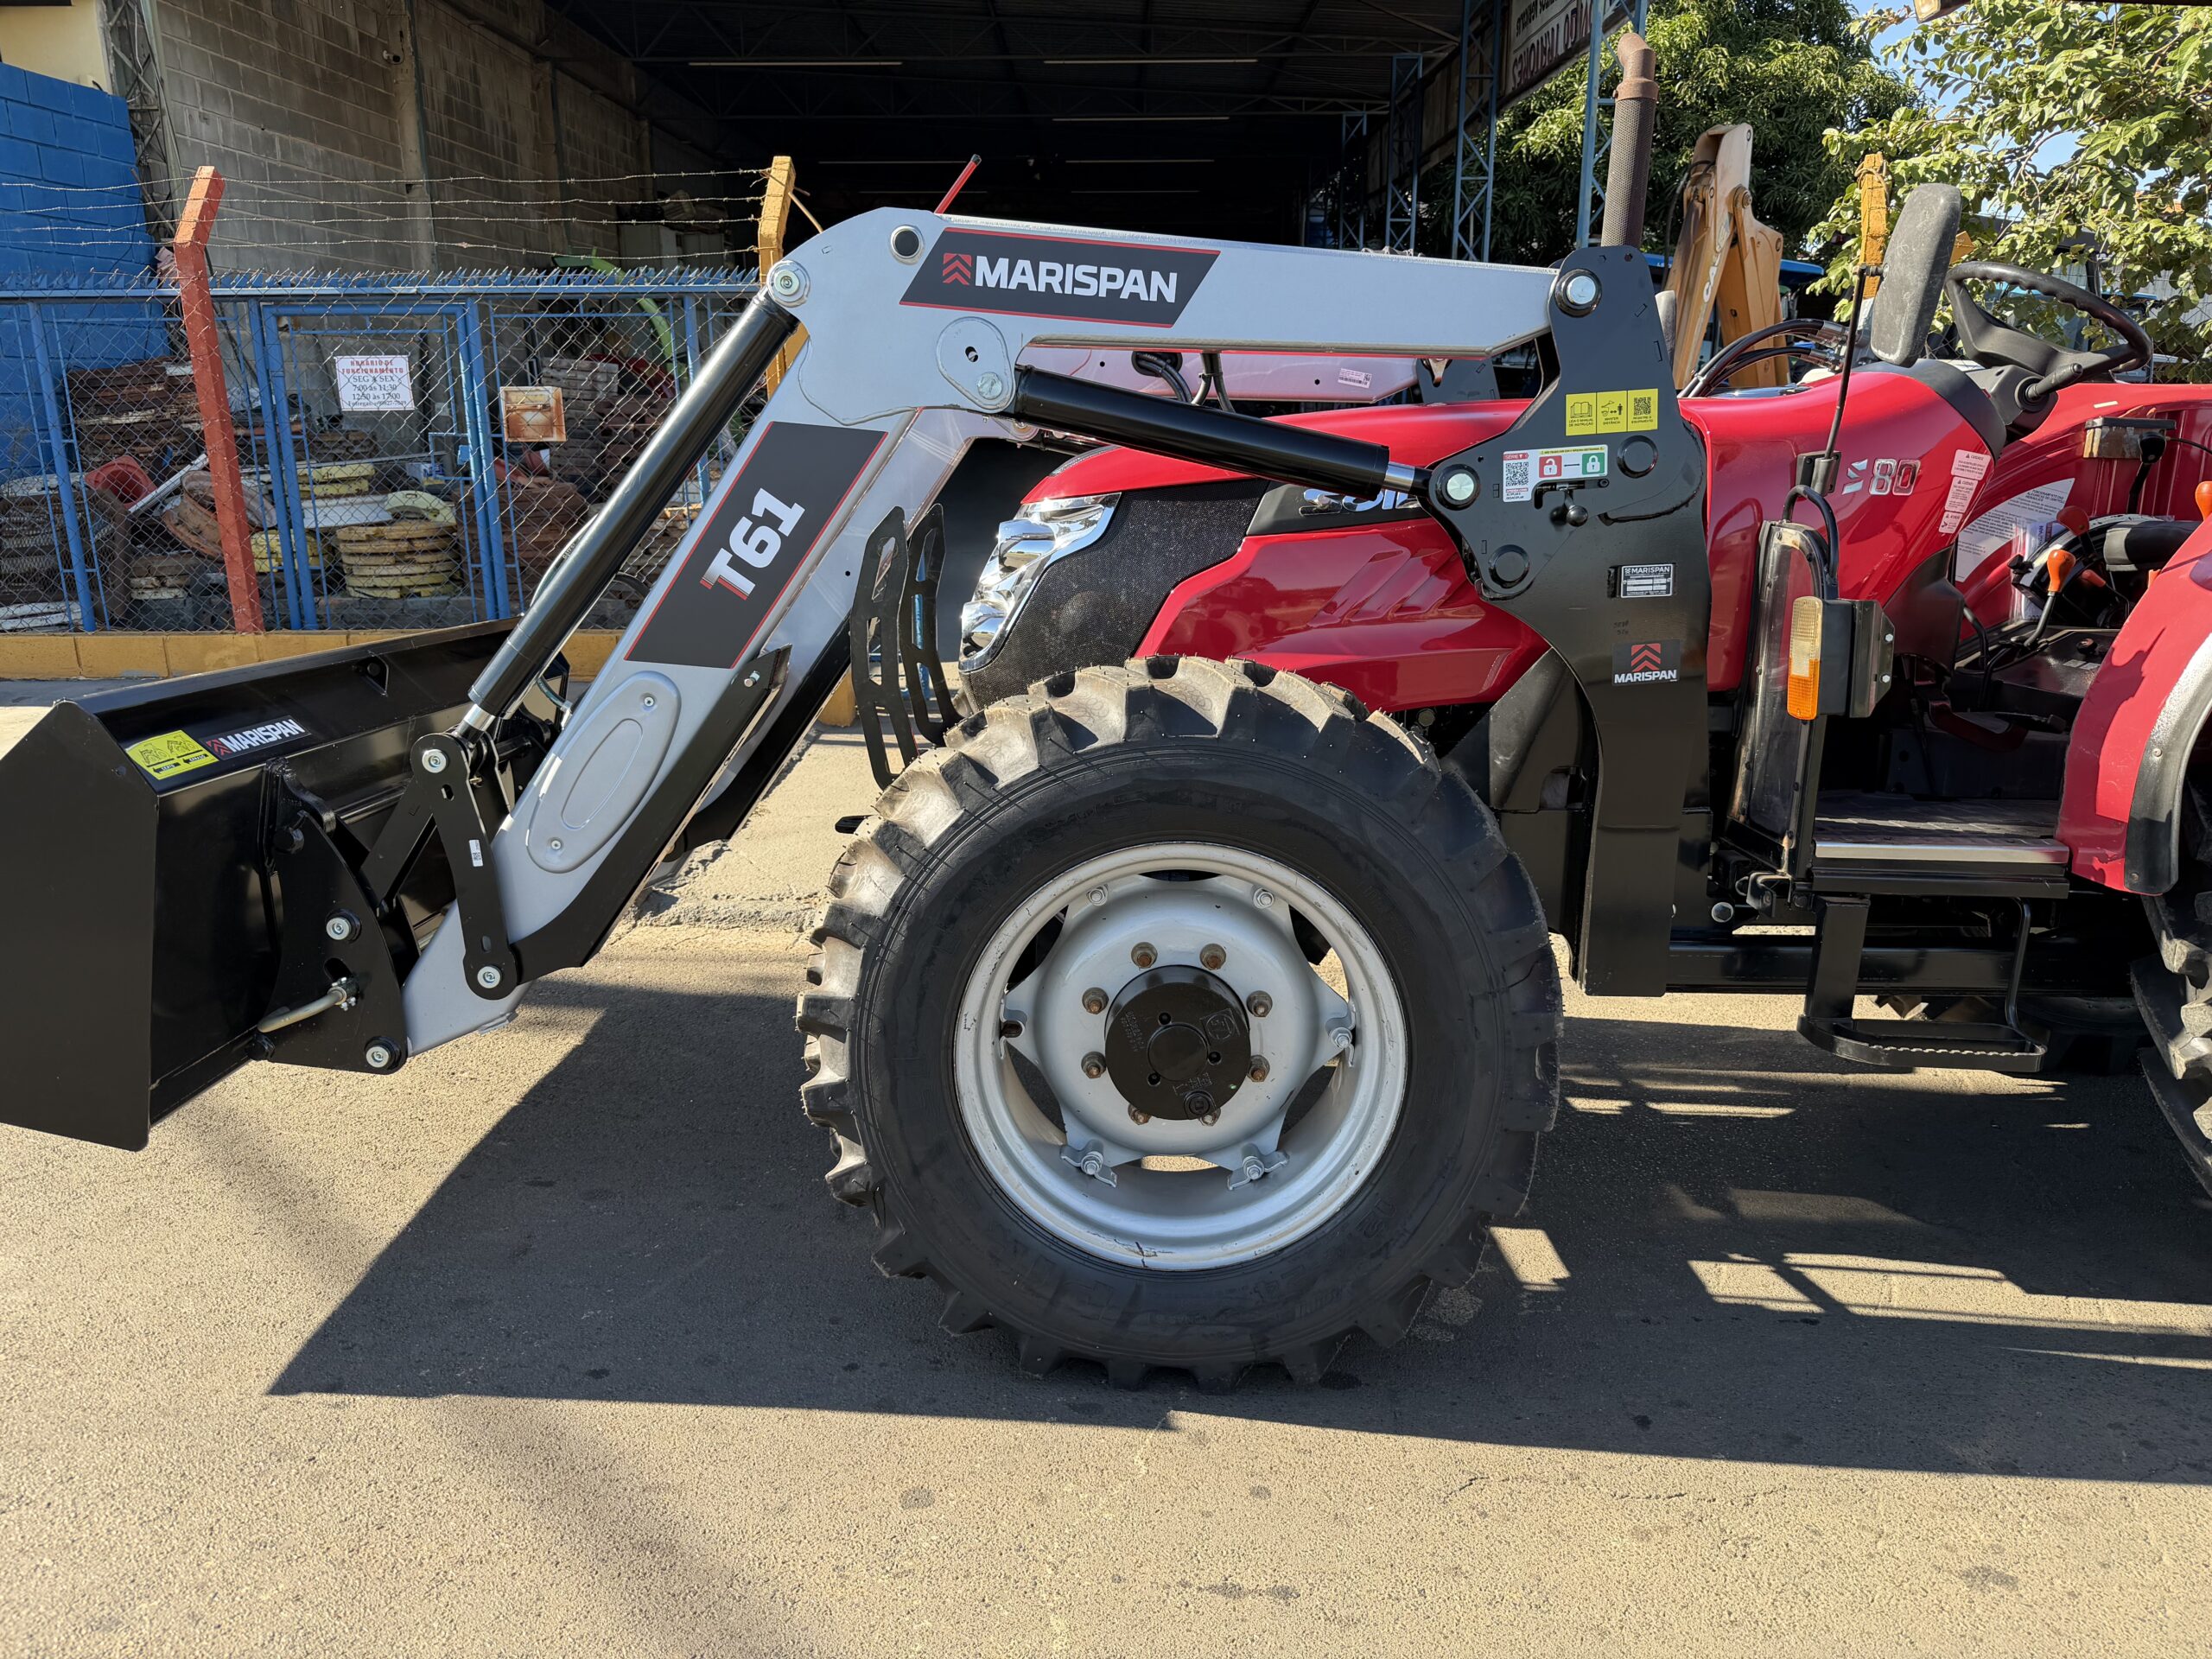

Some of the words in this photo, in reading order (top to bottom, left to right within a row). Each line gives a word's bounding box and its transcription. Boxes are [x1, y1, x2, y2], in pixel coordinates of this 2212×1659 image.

[975, 255, 1178, 303] MARISPAN
[699, 487, 805, 601] T61
[1614, 670, 1677, 683] MARISPAN
[221, 719, 305, 753] MARISPAN
